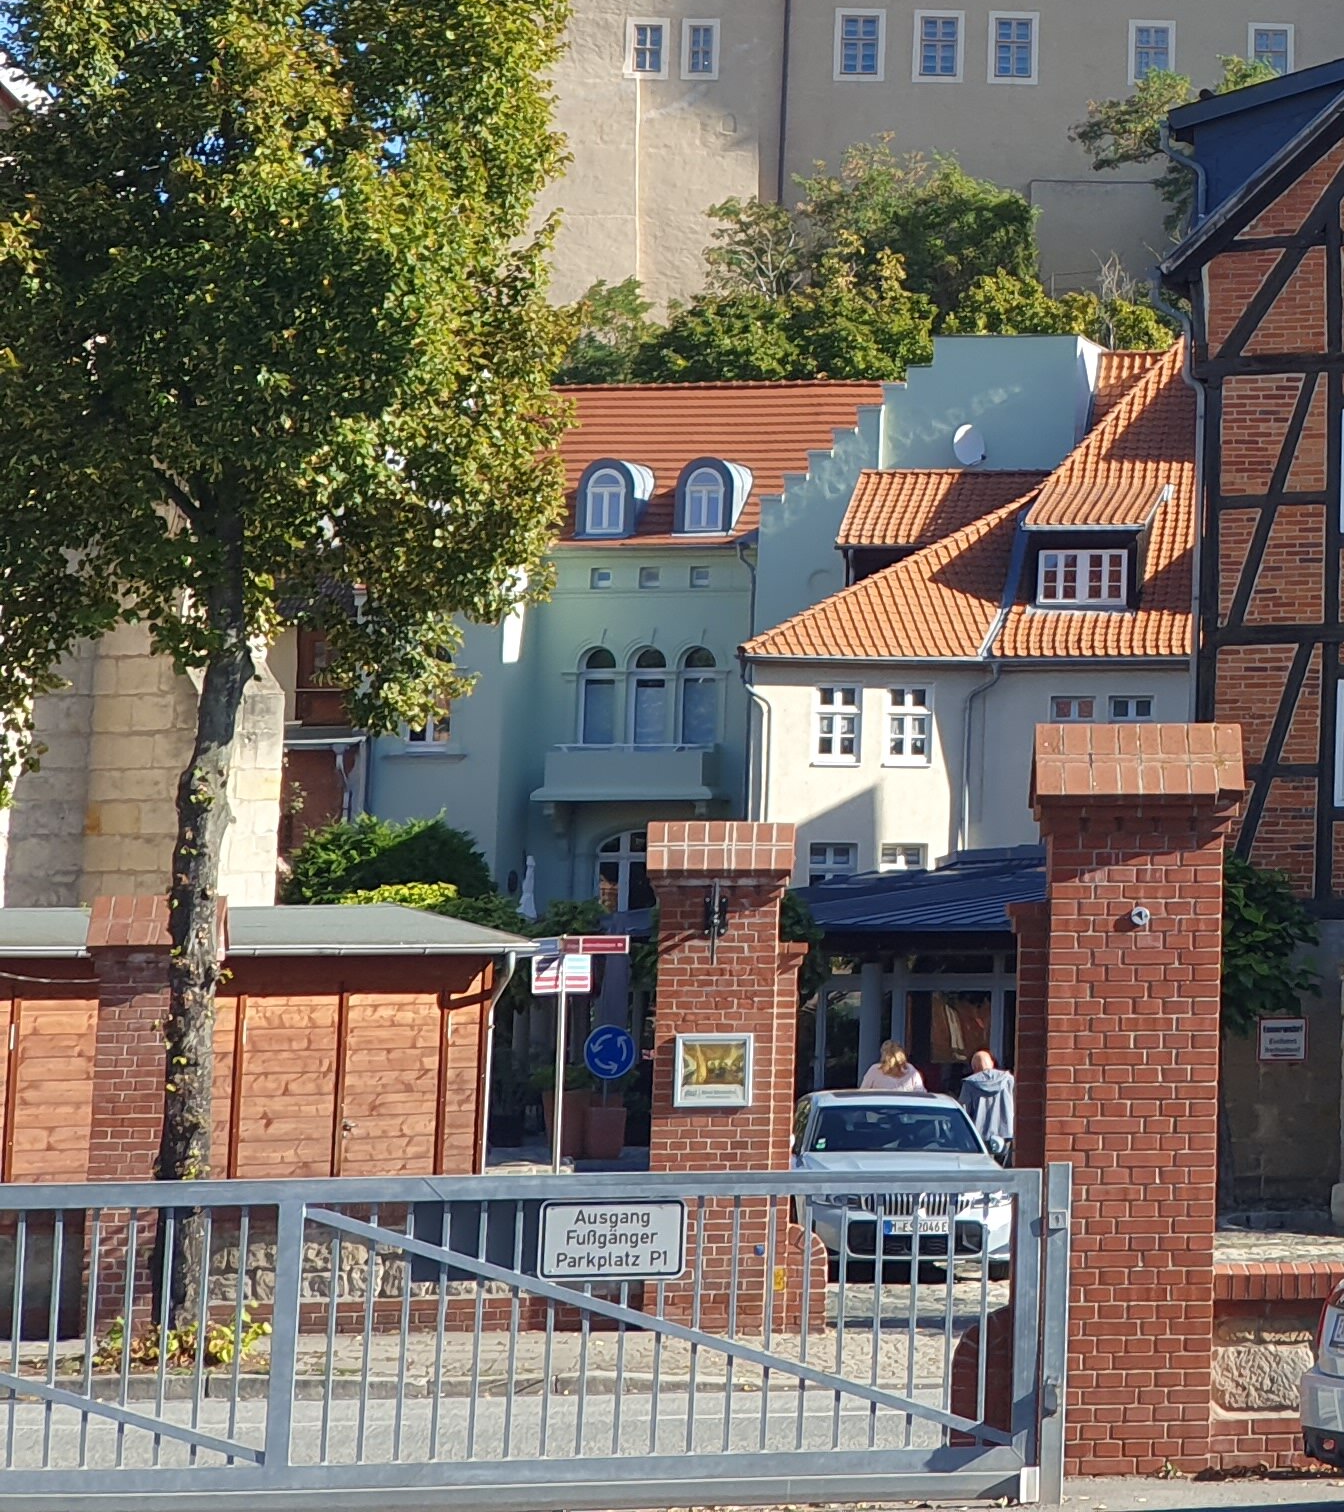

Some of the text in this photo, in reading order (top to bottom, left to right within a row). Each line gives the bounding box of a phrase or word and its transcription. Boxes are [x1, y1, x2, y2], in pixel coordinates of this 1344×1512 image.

[574, 1209, 651, 1229] Ausgang
[566, 1227, 659, 1249] Fußgänger
[556, 1250, 668, 1271] Parkplatz P1
